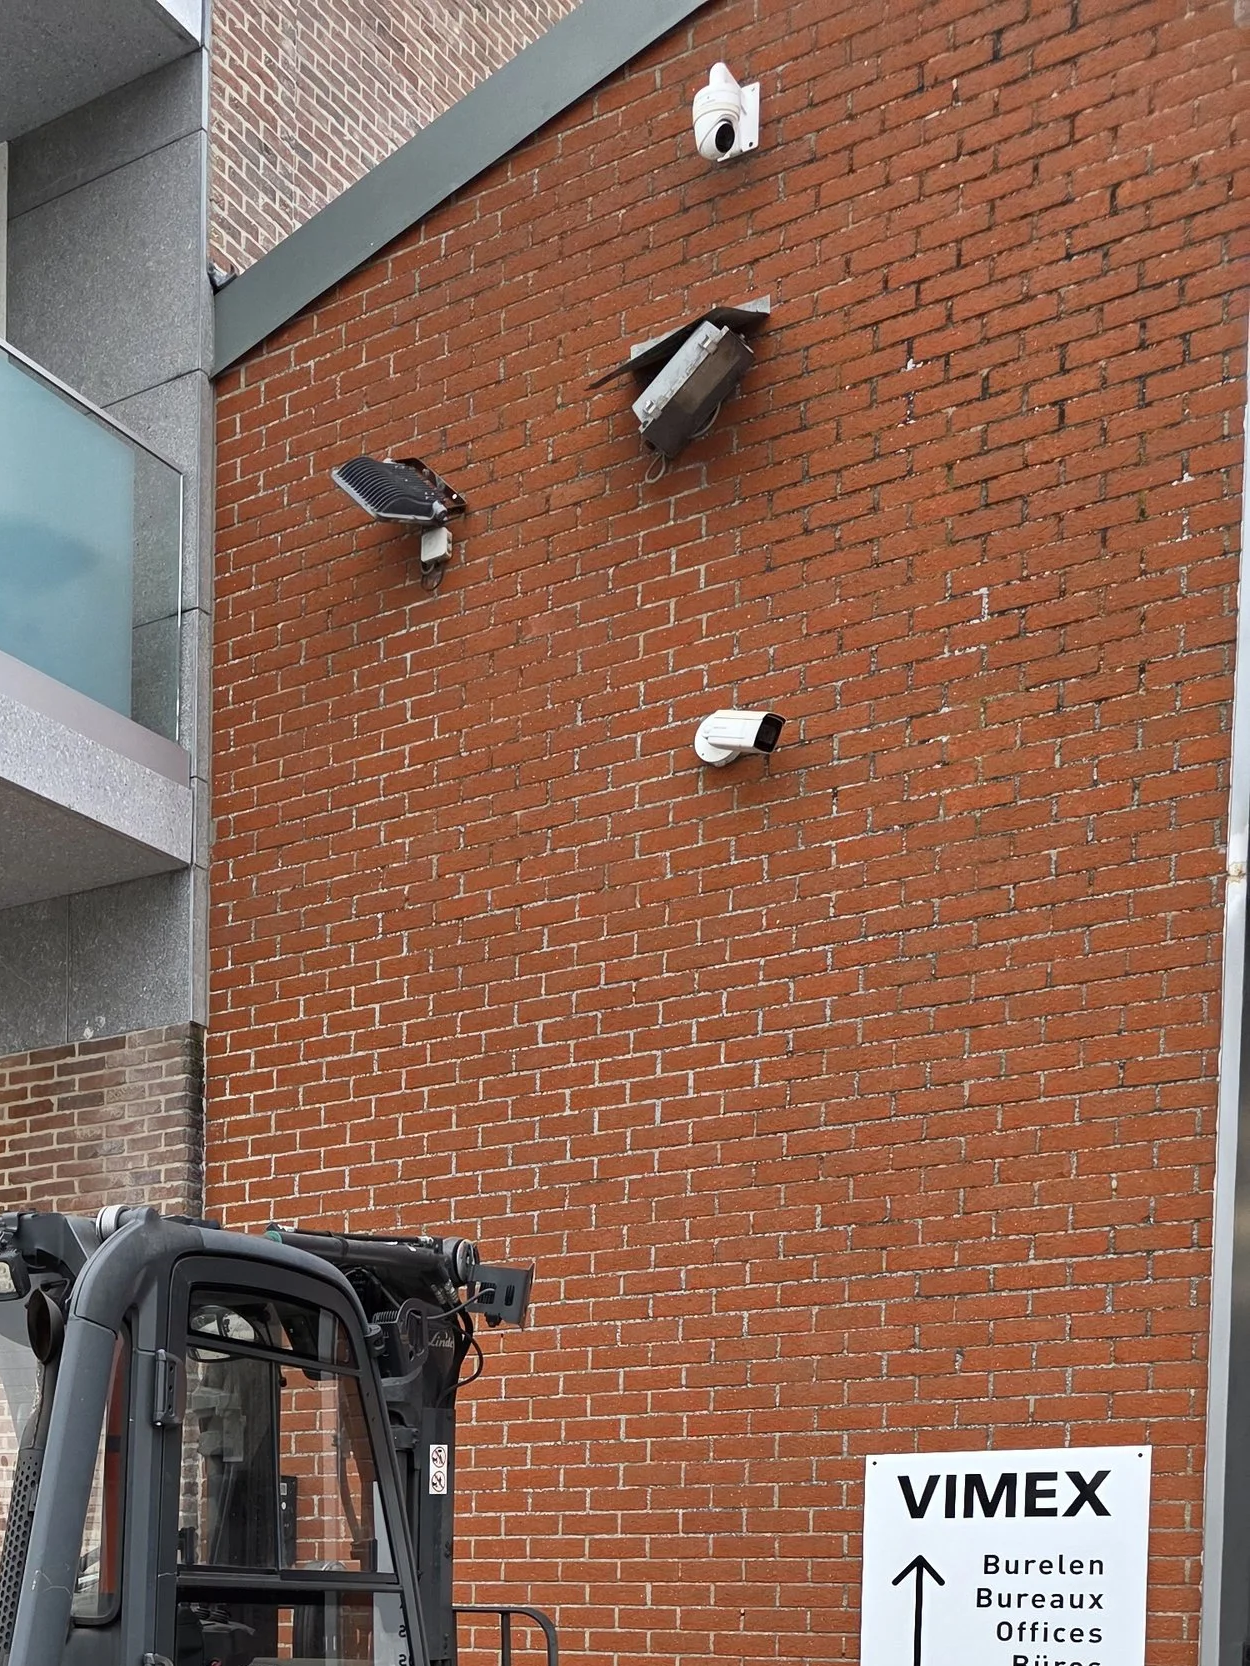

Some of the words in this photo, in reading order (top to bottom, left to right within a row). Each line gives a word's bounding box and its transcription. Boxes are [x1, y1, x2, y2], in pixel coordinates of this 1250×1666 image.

[897, 1470, 1112, 1519] VIMEX
[983, 1554, 1104, 1575] Burelen
[976, 1588, 1104, 1609] Bureaux
[996, 1621, 1103, 1643] Offices
